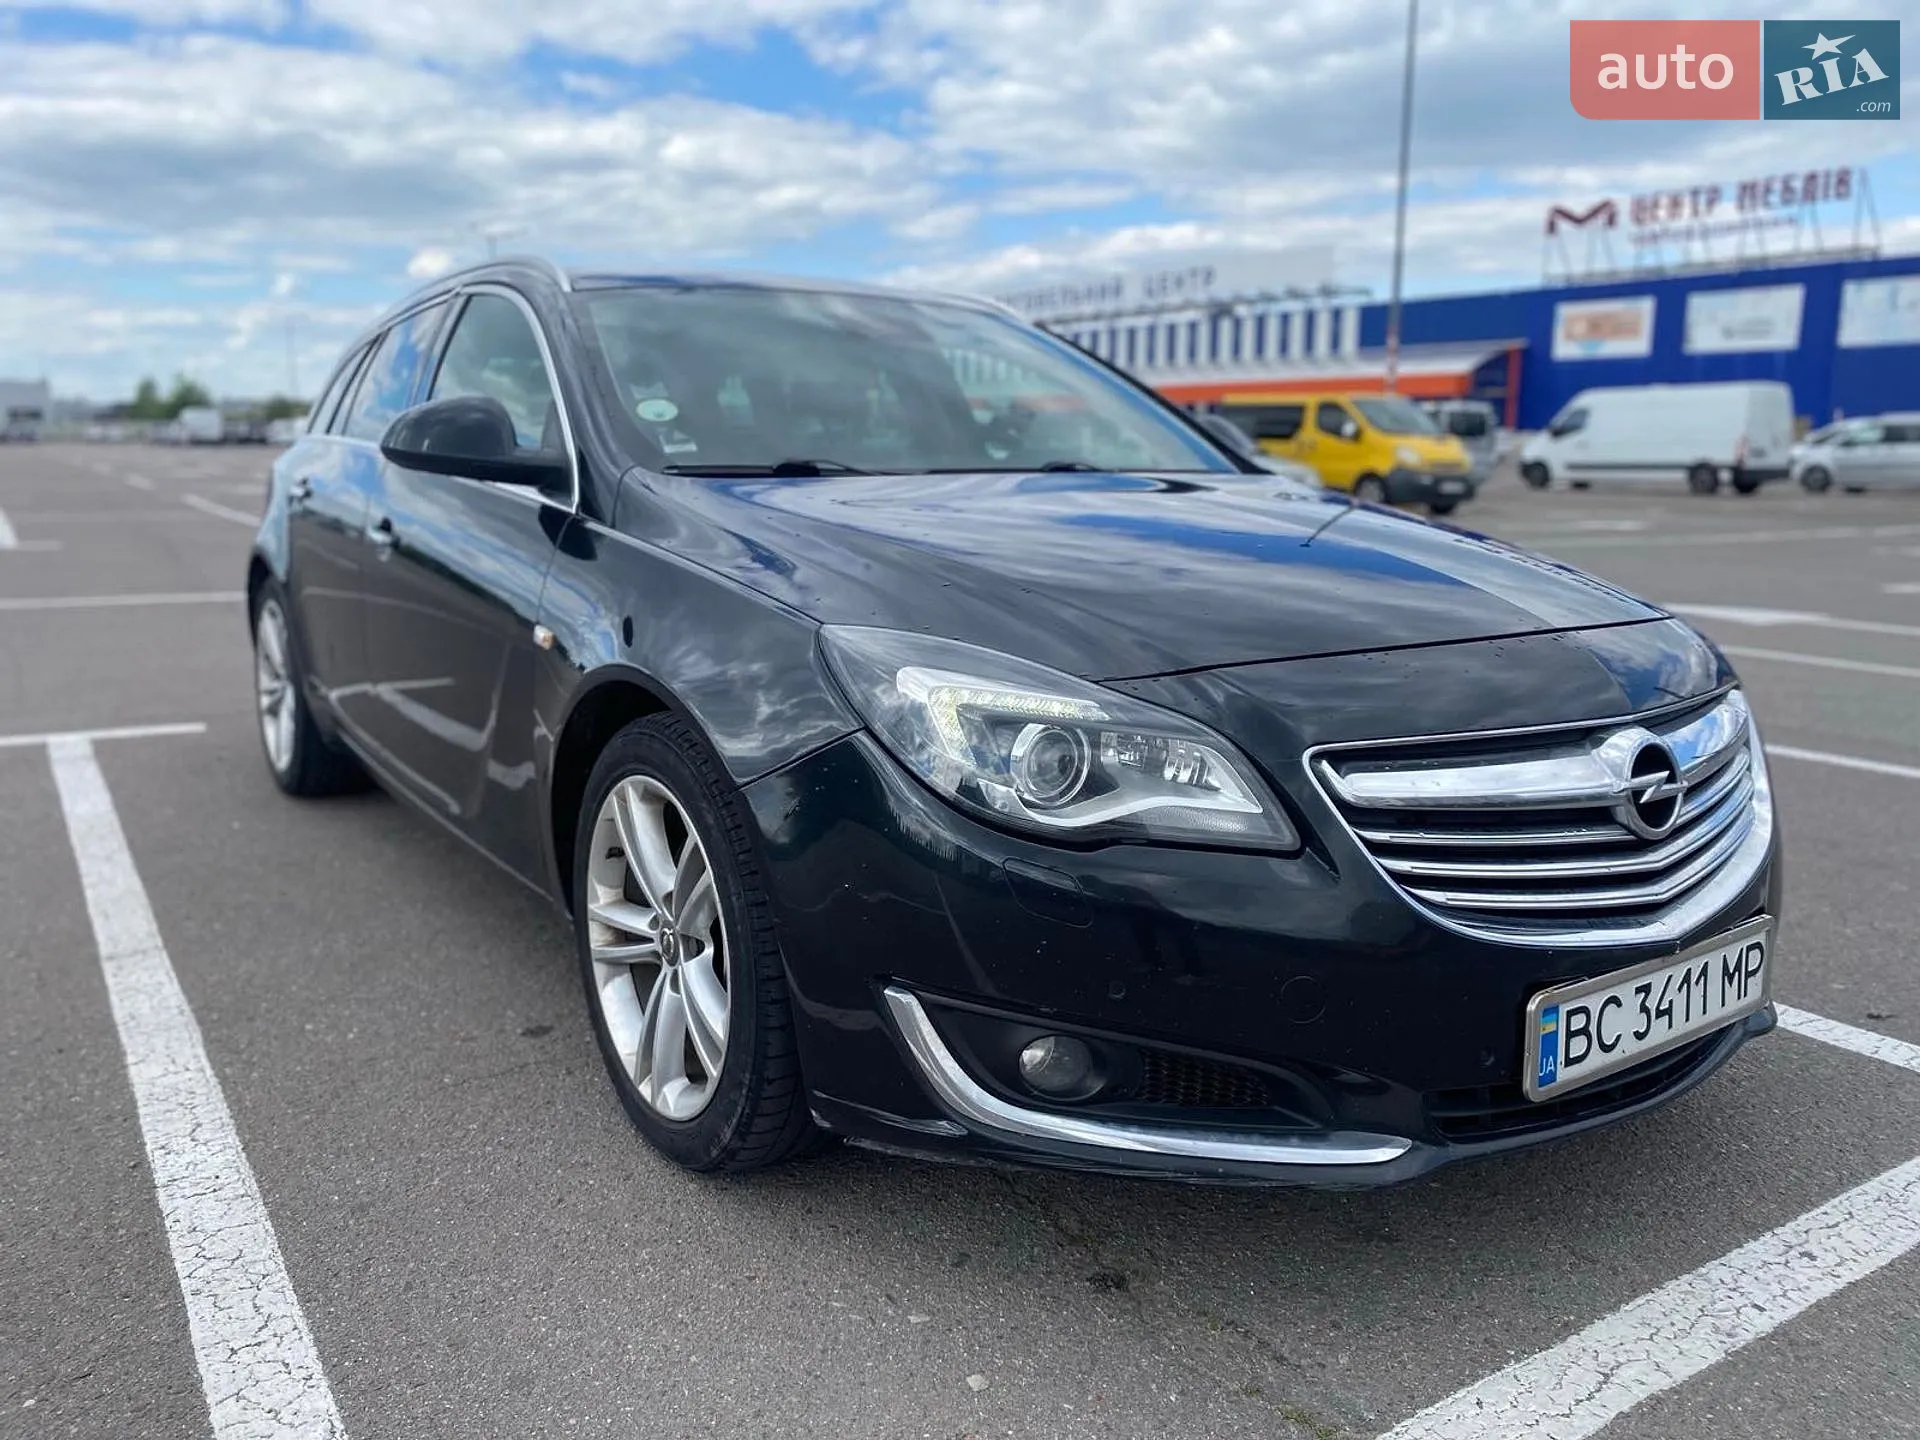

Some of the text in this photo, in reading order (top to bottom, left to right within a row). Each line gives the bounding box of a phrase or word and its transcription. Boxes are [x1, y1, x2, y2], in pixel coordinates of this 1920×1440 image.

[1629, 185, 1721, 225] ЦЕНТР
[1564, 941, 1765, 1068] BC 3411 MP
[1538, 1056, 1555, 1077] UA
